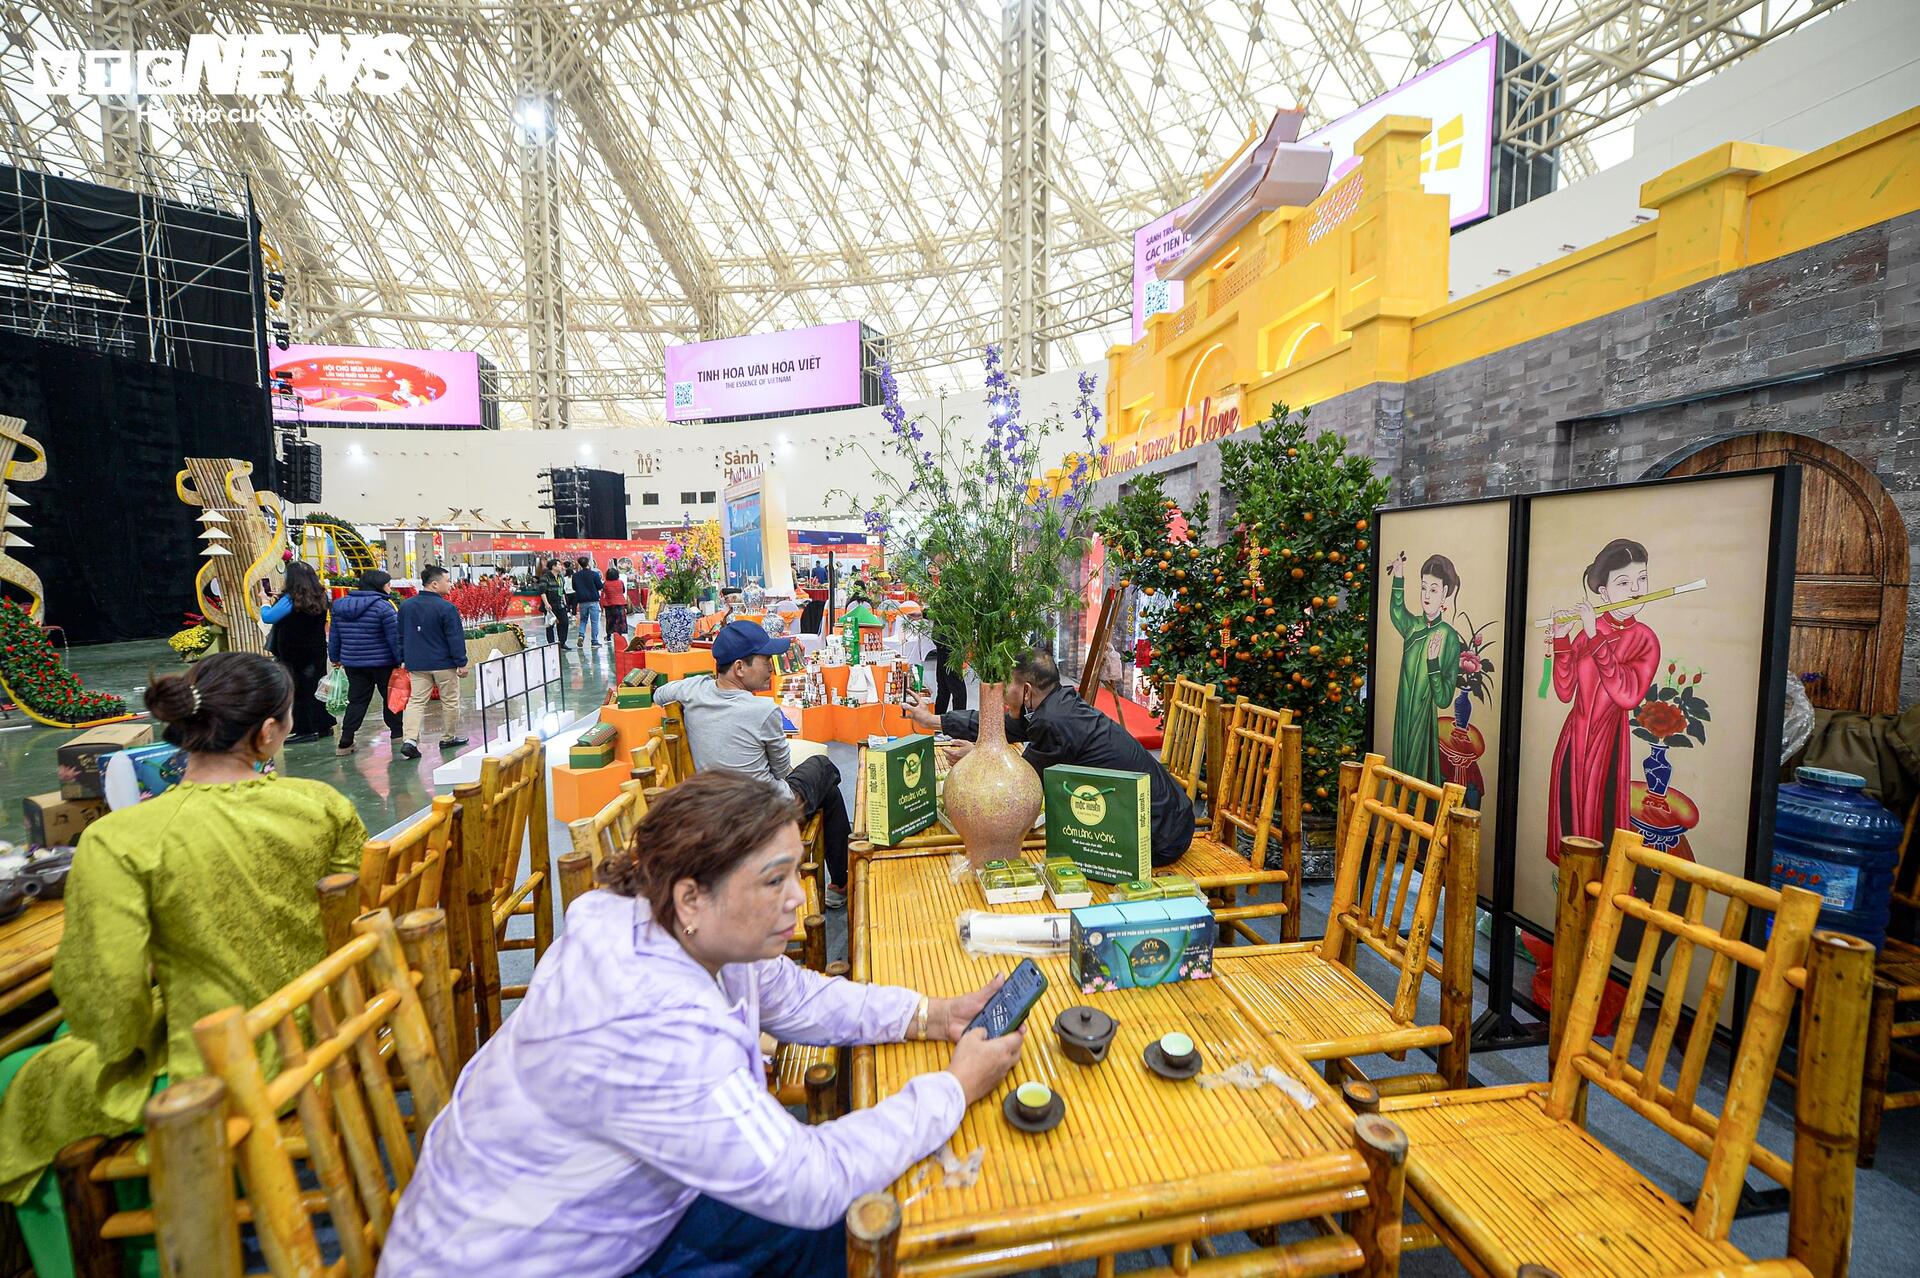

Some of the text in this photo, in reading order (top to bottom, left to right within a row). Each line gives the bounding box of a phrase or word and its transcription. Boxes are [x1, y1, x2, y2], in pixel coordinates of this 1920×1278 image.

[697, 369, 720, 383] TINH
[723, 366, 745, 380] HOA
[725, 375, 791, 390] THE ESSENCE OF VIETNAM
[1141, 431, 1176, 465] come
[1179, 407, 1197, 451] to
[1200, 396, 1240, 444] love
[724, 449, 759, 466] Sảnh
